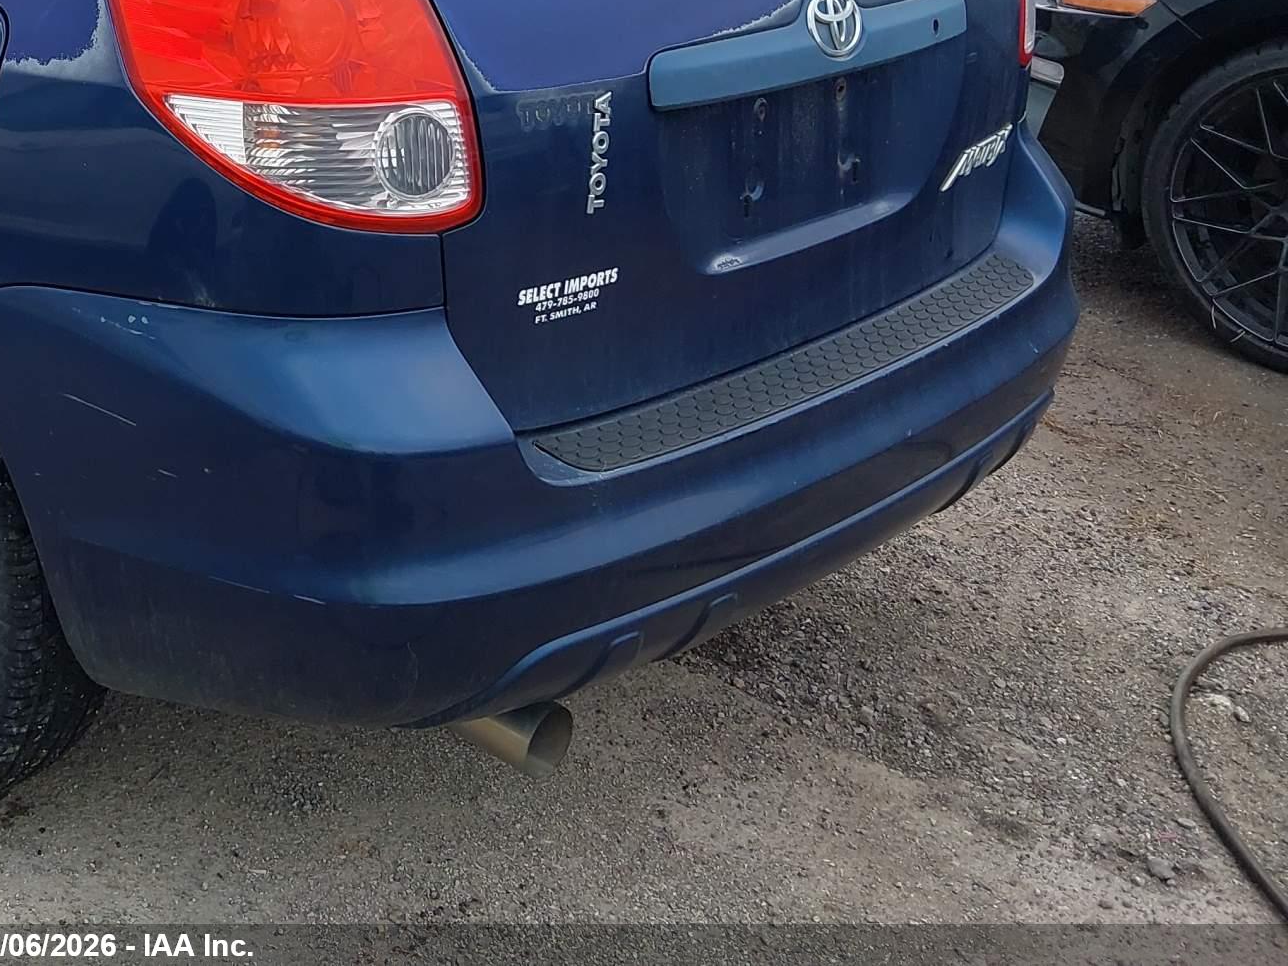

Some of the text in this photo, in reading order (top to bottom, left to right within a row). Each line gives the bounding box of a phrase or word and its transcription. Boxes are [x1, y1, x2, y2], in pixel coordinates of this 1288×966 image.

[587, 91, 612, 214] TOYOTA
[517, 267, 619, 306] SELECT IMPORTS
[535, 288, 600, 312] 479-785-9800
[549, 305, 582, 321] SMITH,
[583, 301, 597, 312] AR
